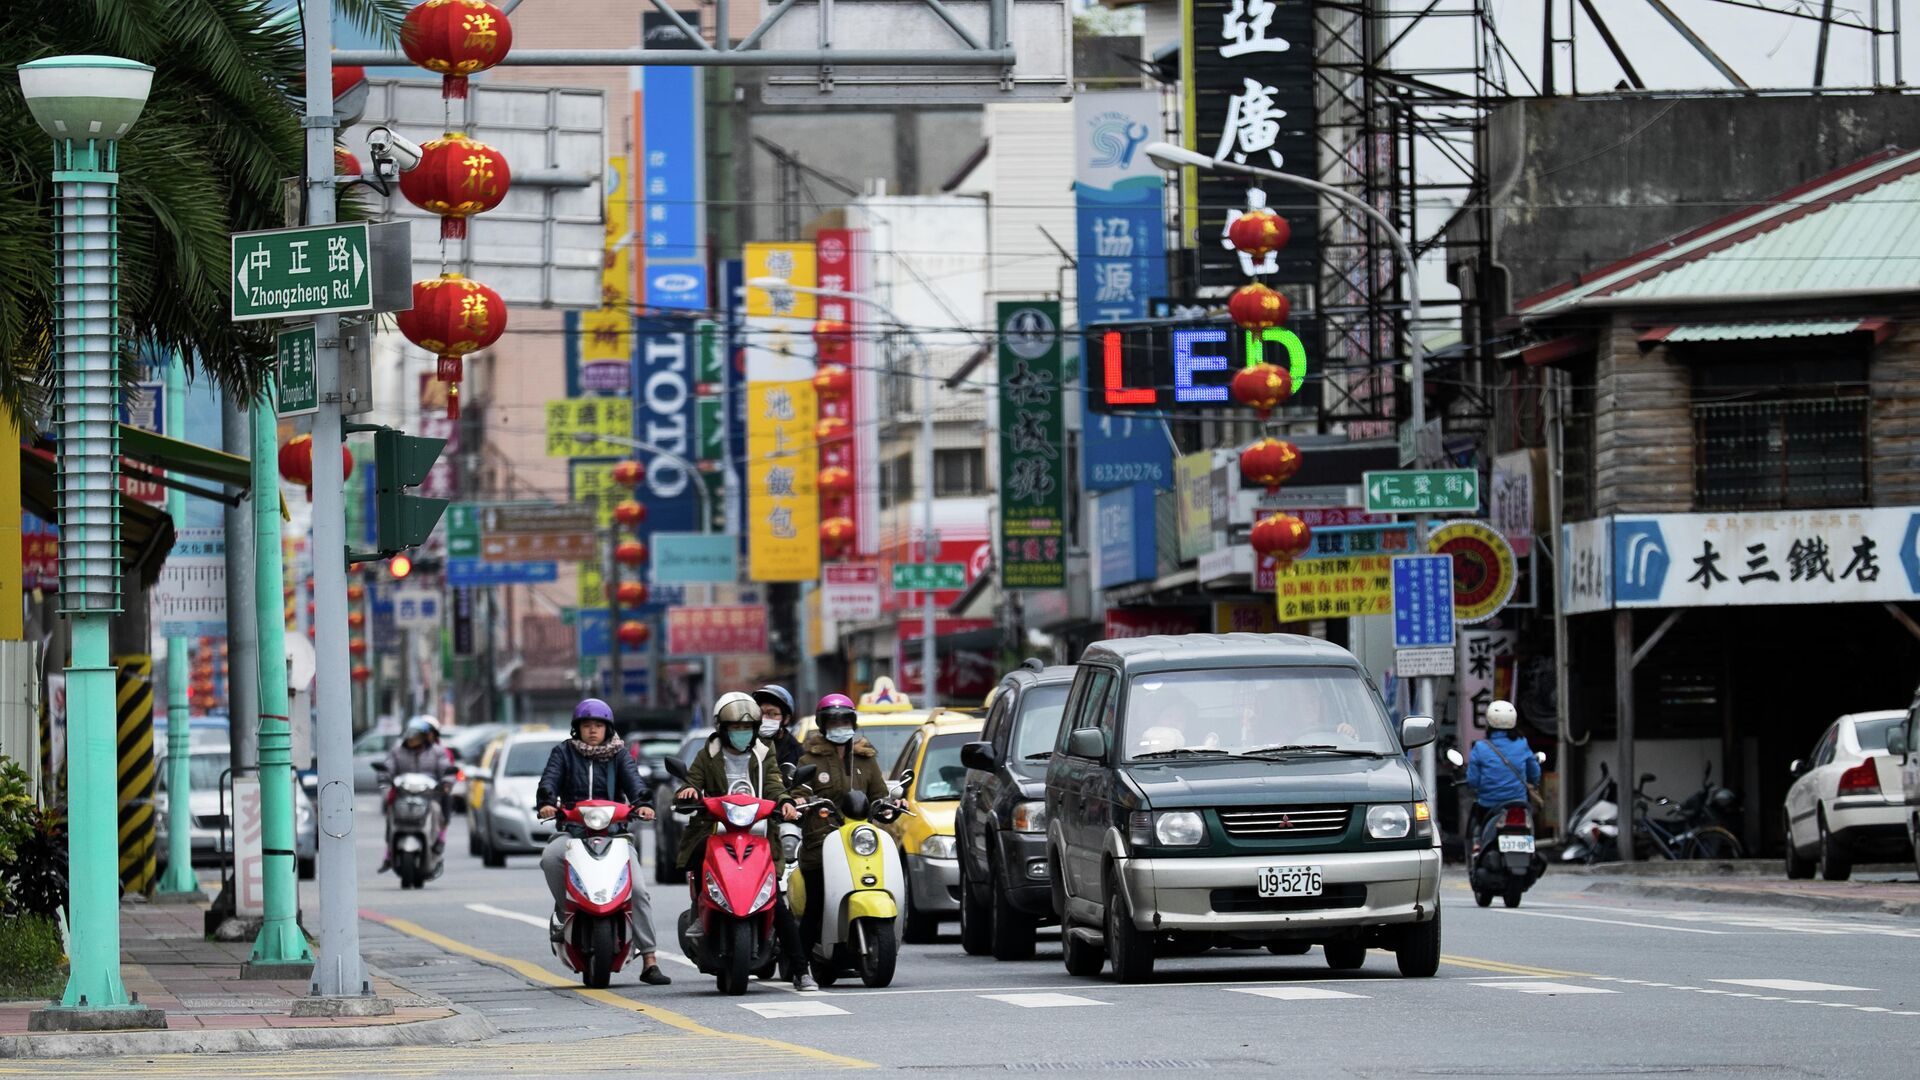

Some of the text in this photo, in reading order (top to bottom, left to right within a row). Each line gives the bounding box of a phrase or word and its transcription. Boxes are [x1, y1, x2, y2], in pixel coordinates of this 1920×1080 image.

[462, 12, 498, 51] 滿
[462, 154, 498, 197] 花
[251, 236, 350, 281] 中正路
[251, 279, 353, 309] Zhongzheng Rd.
[459, 292, 490, 337] 蓮
[283, 337, 312, 378] 中華路
[1103, 327, 1307, 404] LED
[644, 332, 689, 498] TOTO
[1091, 464, 1163, 482] 8320276
[1382, 474, 1463, 495] 仁愛街
[1436, 495, 1453, 507] St.
[1687, 535, 1881, 591] 木三鐵店
[1258, 873, 1321, 893] U9-5276
